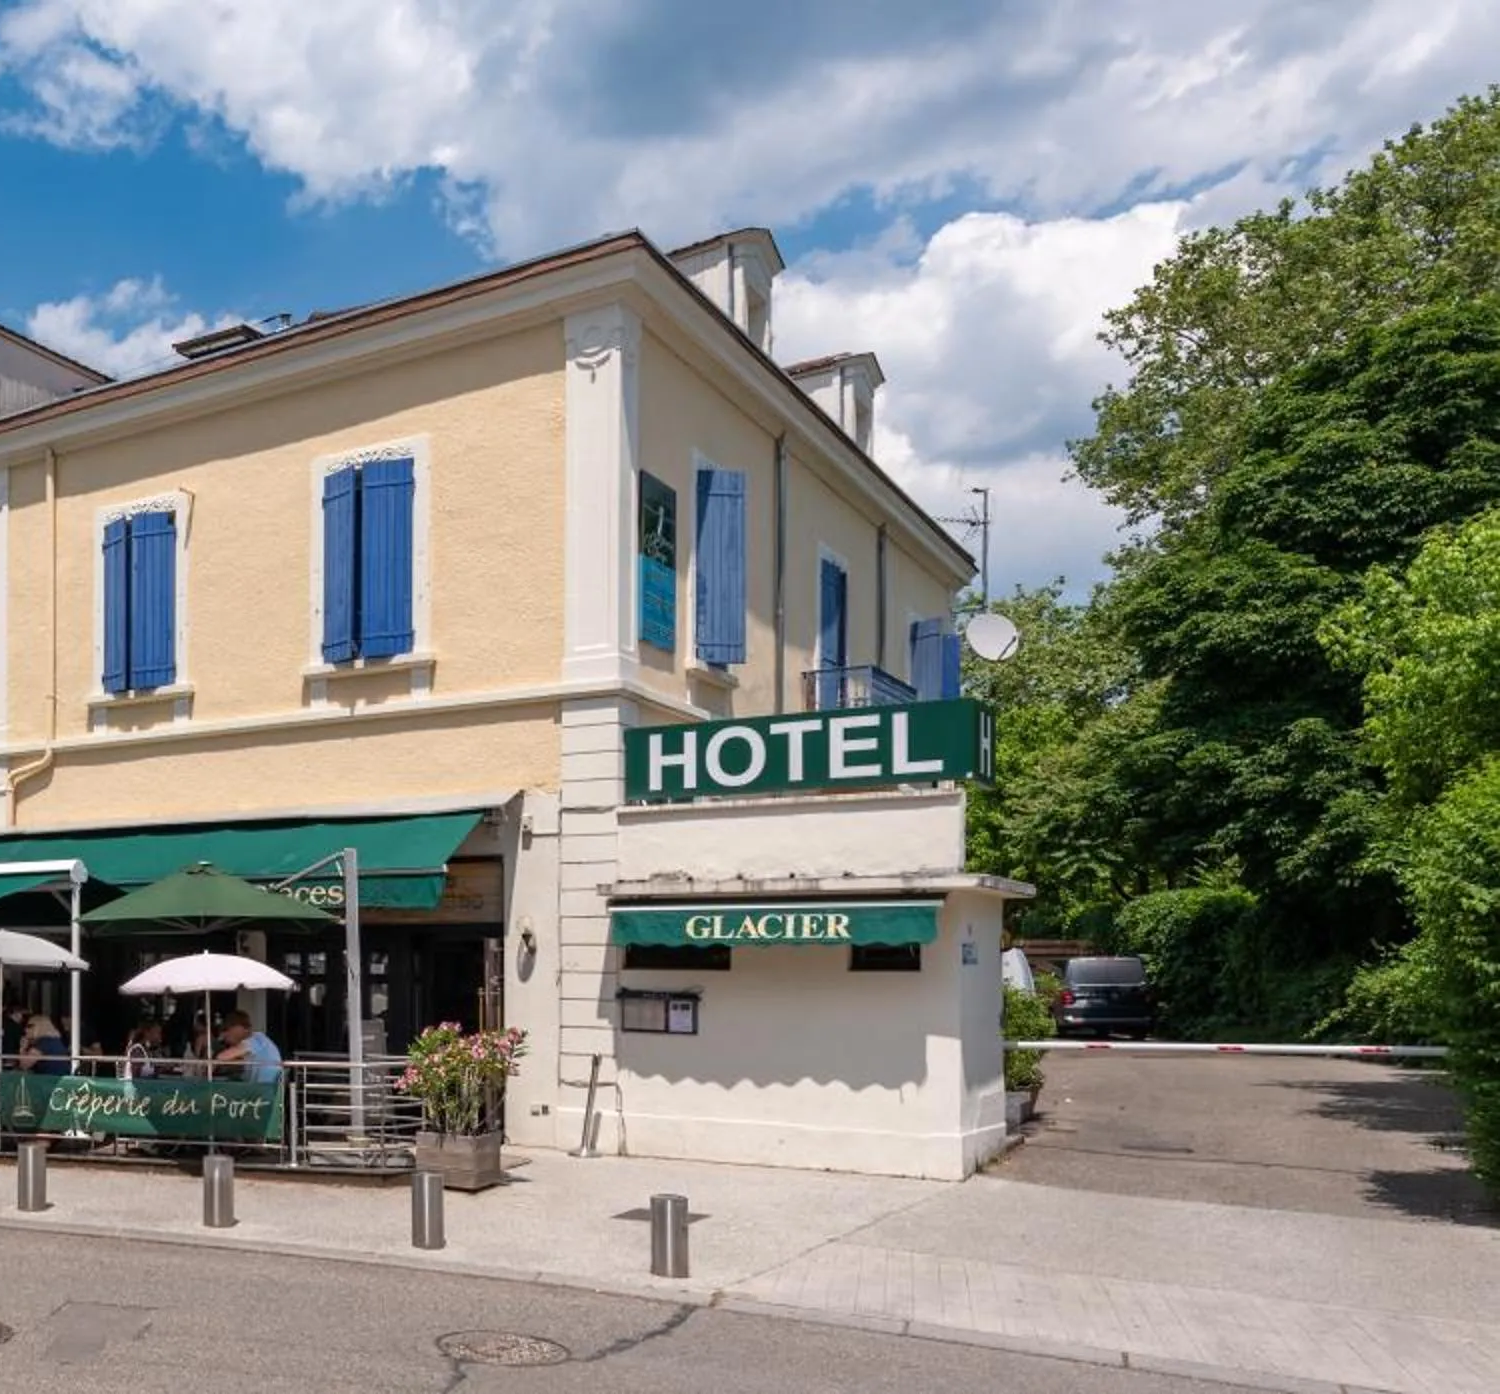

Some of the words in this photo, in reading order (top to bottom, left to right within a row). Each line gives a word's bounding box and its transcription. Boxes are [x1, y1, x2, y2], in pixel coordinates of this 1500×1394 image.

[649, 712, 944, 791] HOTEL
[979, 711, 992, 778] H
[685, 912, 852, 940] GLACIER
[49, 1081, 151, 1129] Crêperie
[161, 1089, 199, 1116] du
[211, 1093, 271, 1119] Port
